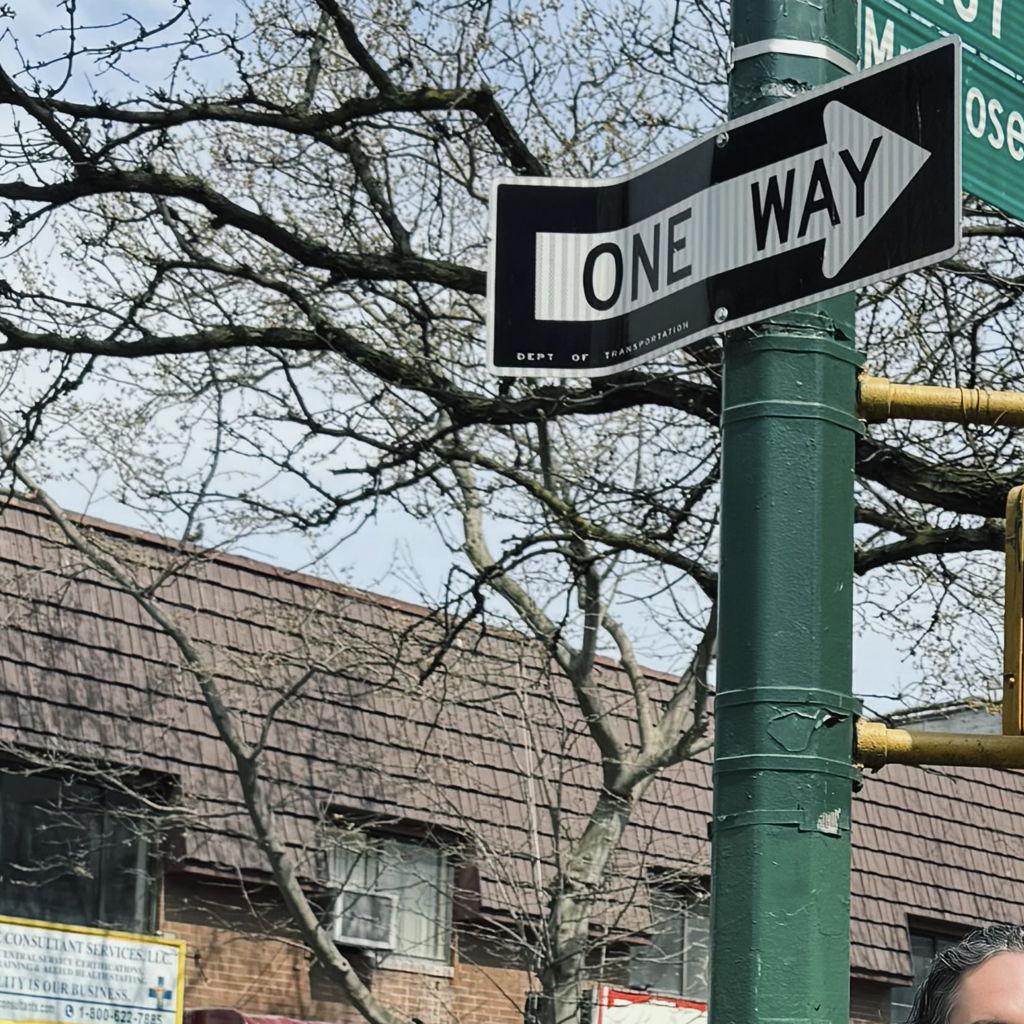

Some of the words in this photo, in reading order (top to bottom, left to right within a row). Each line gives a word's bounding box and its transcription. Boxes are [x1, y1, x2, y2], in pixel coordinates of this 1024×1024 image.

[864, 6, 912, 69] M
[583, 208, 692, 311] ONE
[751, 136, 883, 251] WAY
[517, 352, 554, 361] DEPT
[571, 353, 589, 362] OF
[605, 321, 689, 359] TRANSPORTATION
[3, 950, 35, 961] ENTRAL
[4, 932, 84, 954] CONSULTANT
[29, 979, 40, 991] IS
[43, 980, 68, 994] OUR
